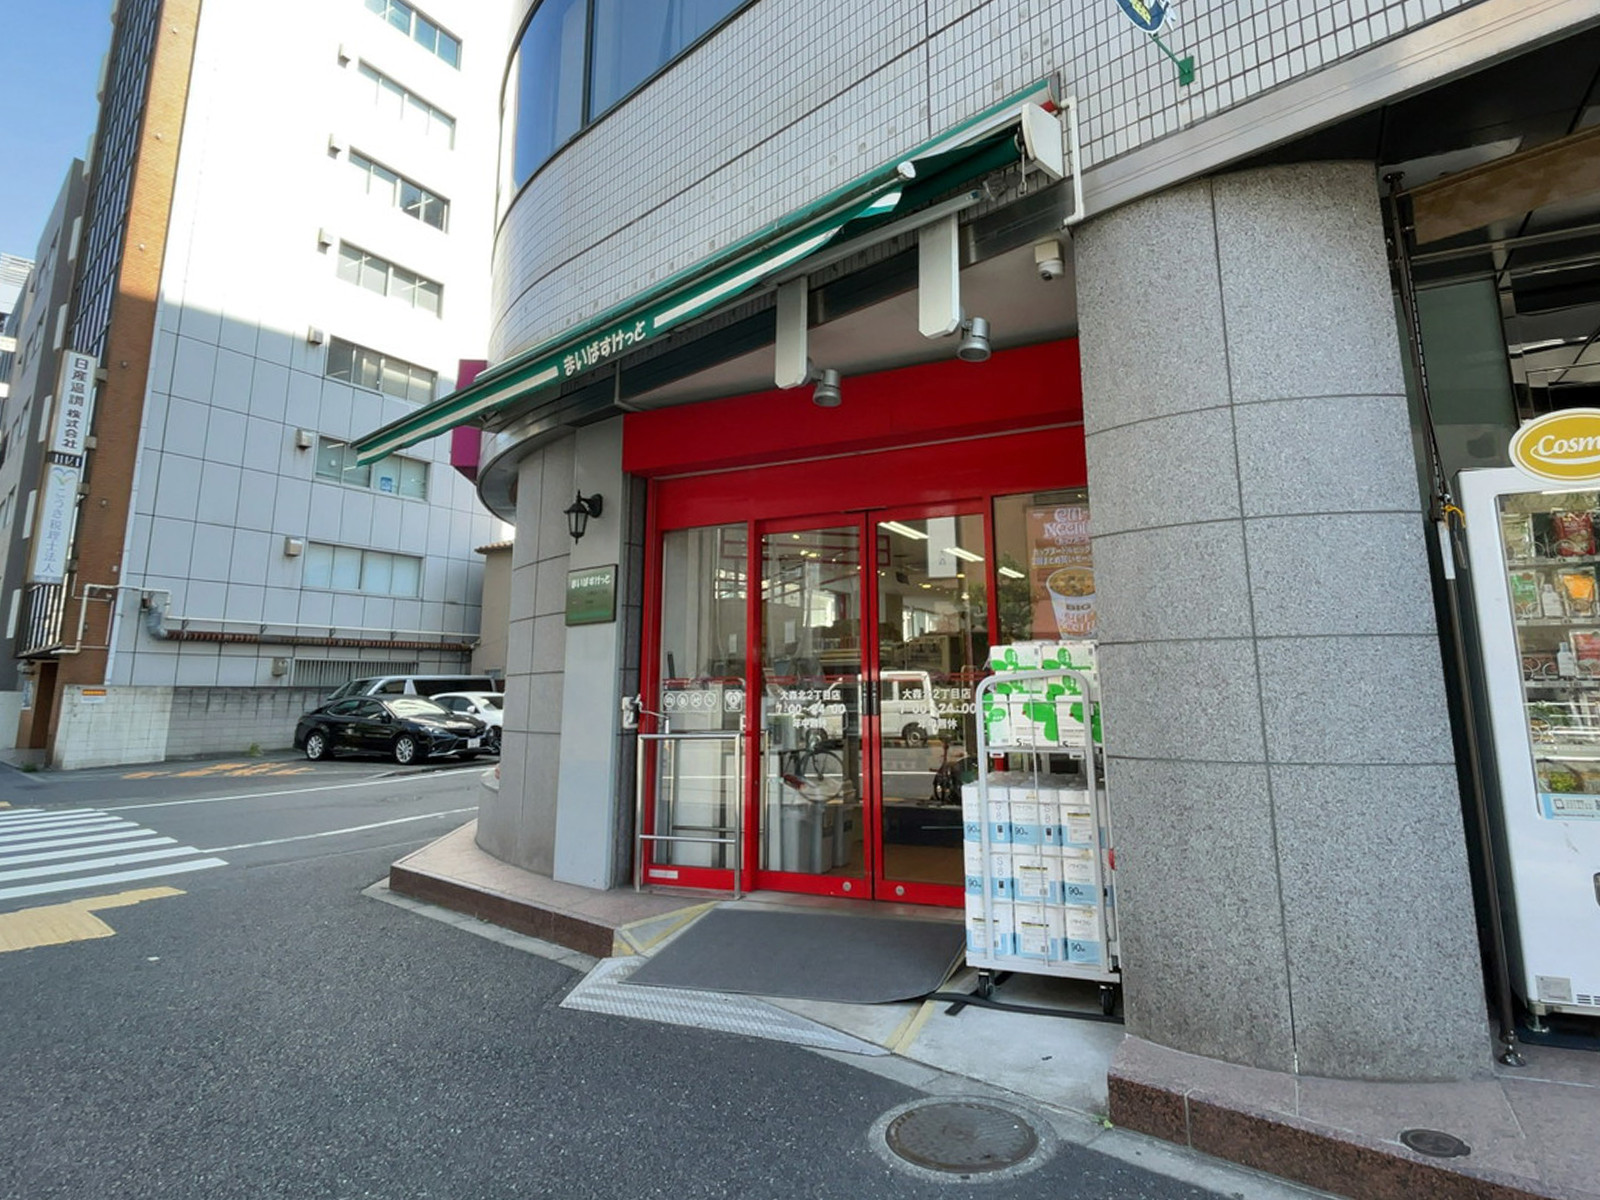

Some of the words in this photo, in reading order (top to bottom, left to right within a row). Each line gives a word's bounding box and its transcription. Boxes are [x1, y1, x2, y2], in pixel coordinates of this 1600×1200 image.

[563, 320, 646, 376] まいばすけっと
